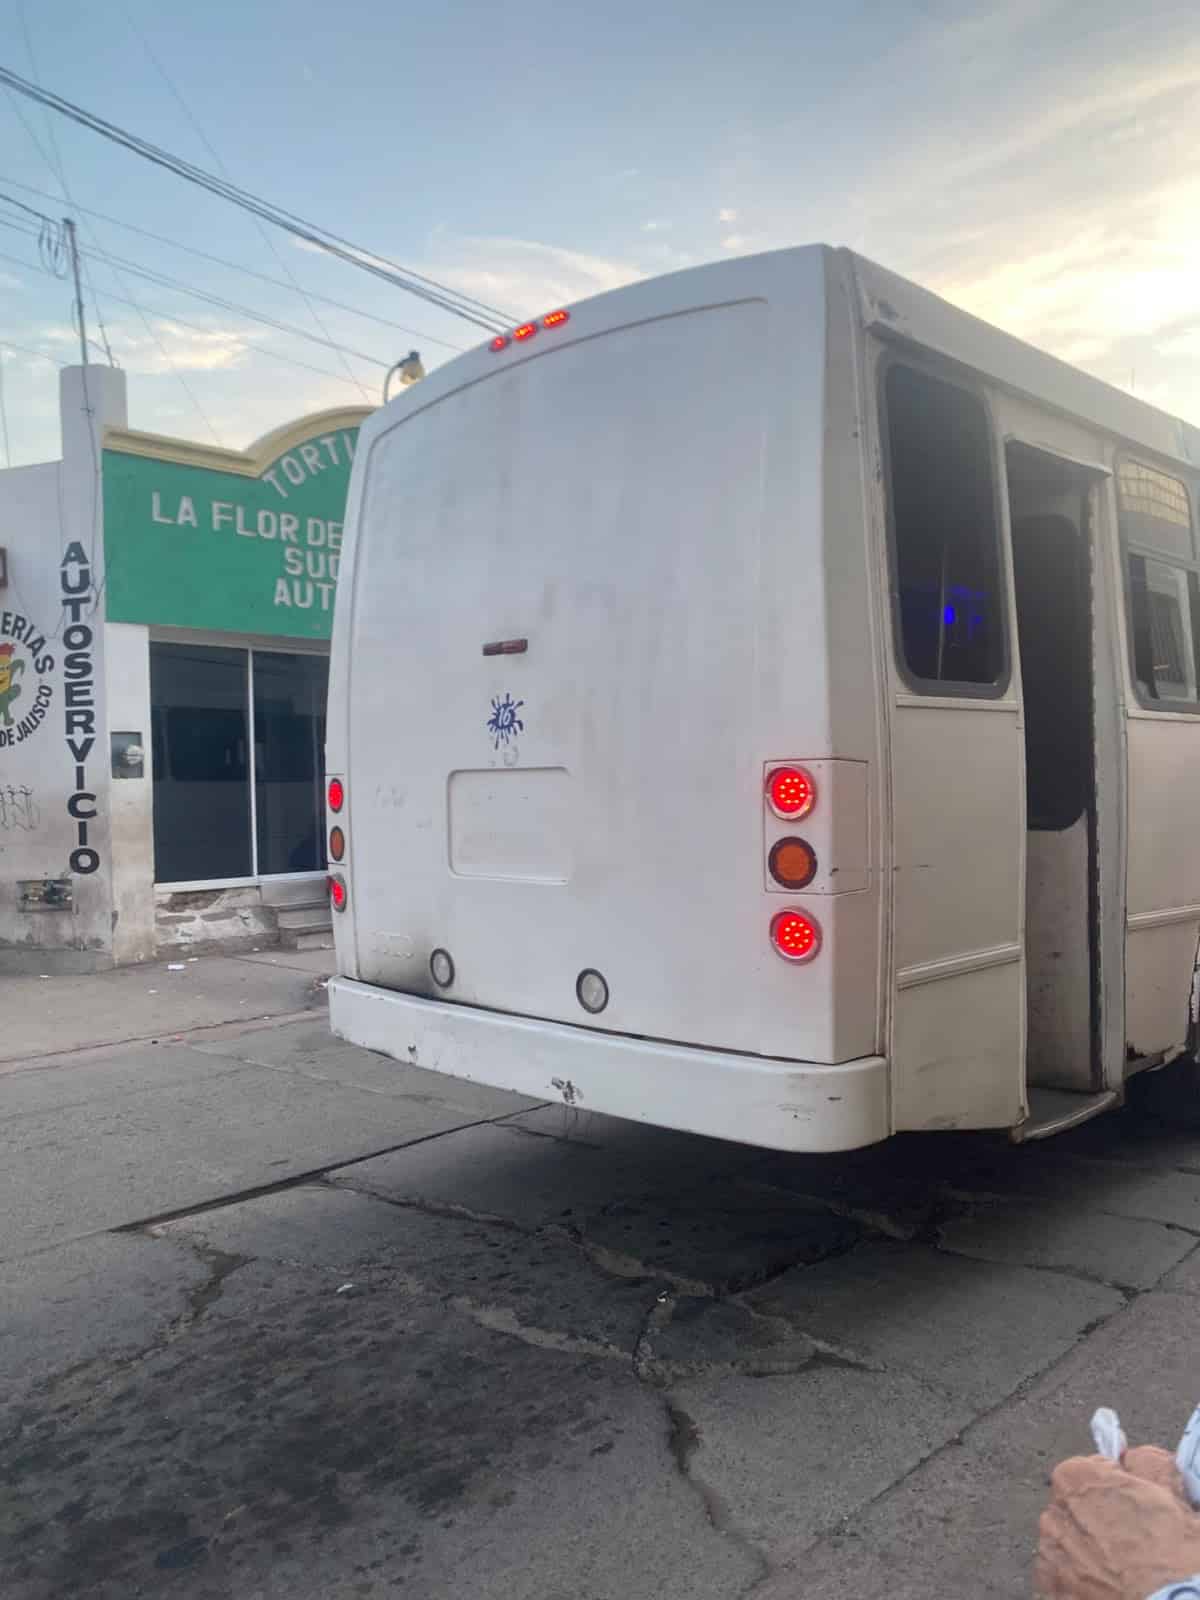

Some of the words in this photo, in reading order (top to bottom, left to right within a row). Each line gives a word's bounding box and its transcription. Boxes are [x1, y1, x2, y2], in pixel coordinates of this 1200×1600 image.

[151, 492, 198, 527] LA
[211, 501, 299, 543] FLOR
[306, 517, 344, 550] DE
[16, 685, 53, 742] JALISCO
[60, 541, 100, 874] AUTOSERVICIO
[498, 706, 513, 727] 16
